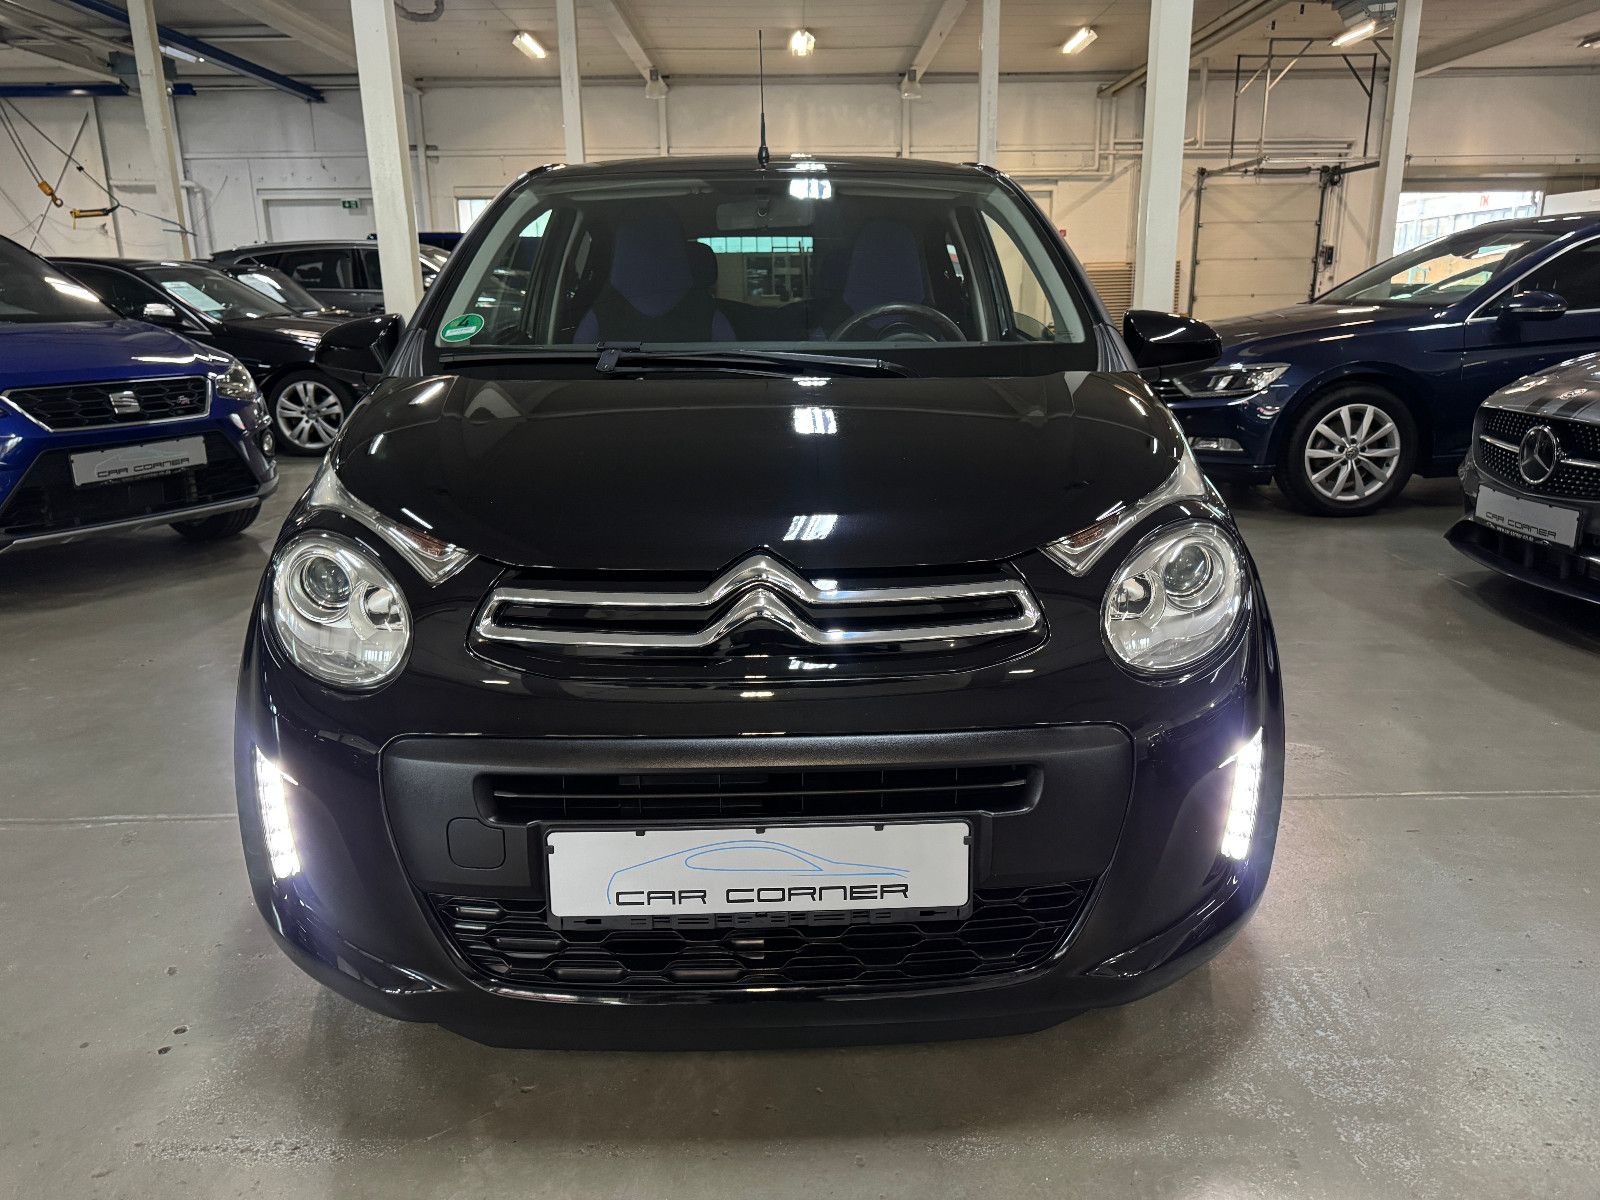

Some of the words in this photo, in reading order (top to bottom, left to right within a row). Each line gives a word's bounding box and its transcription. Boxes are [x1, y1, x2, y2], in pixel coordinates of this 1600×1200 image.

[97, 467, 129, 478] CAR
[133, 457, 190, 473] CORNER
[1485, 511, 1505, 523] CAR
[1507, 519, 1557, 539] CORNER
[615, 889, 707, 906] CAR
[725, 883, 909, 903] CORNER
